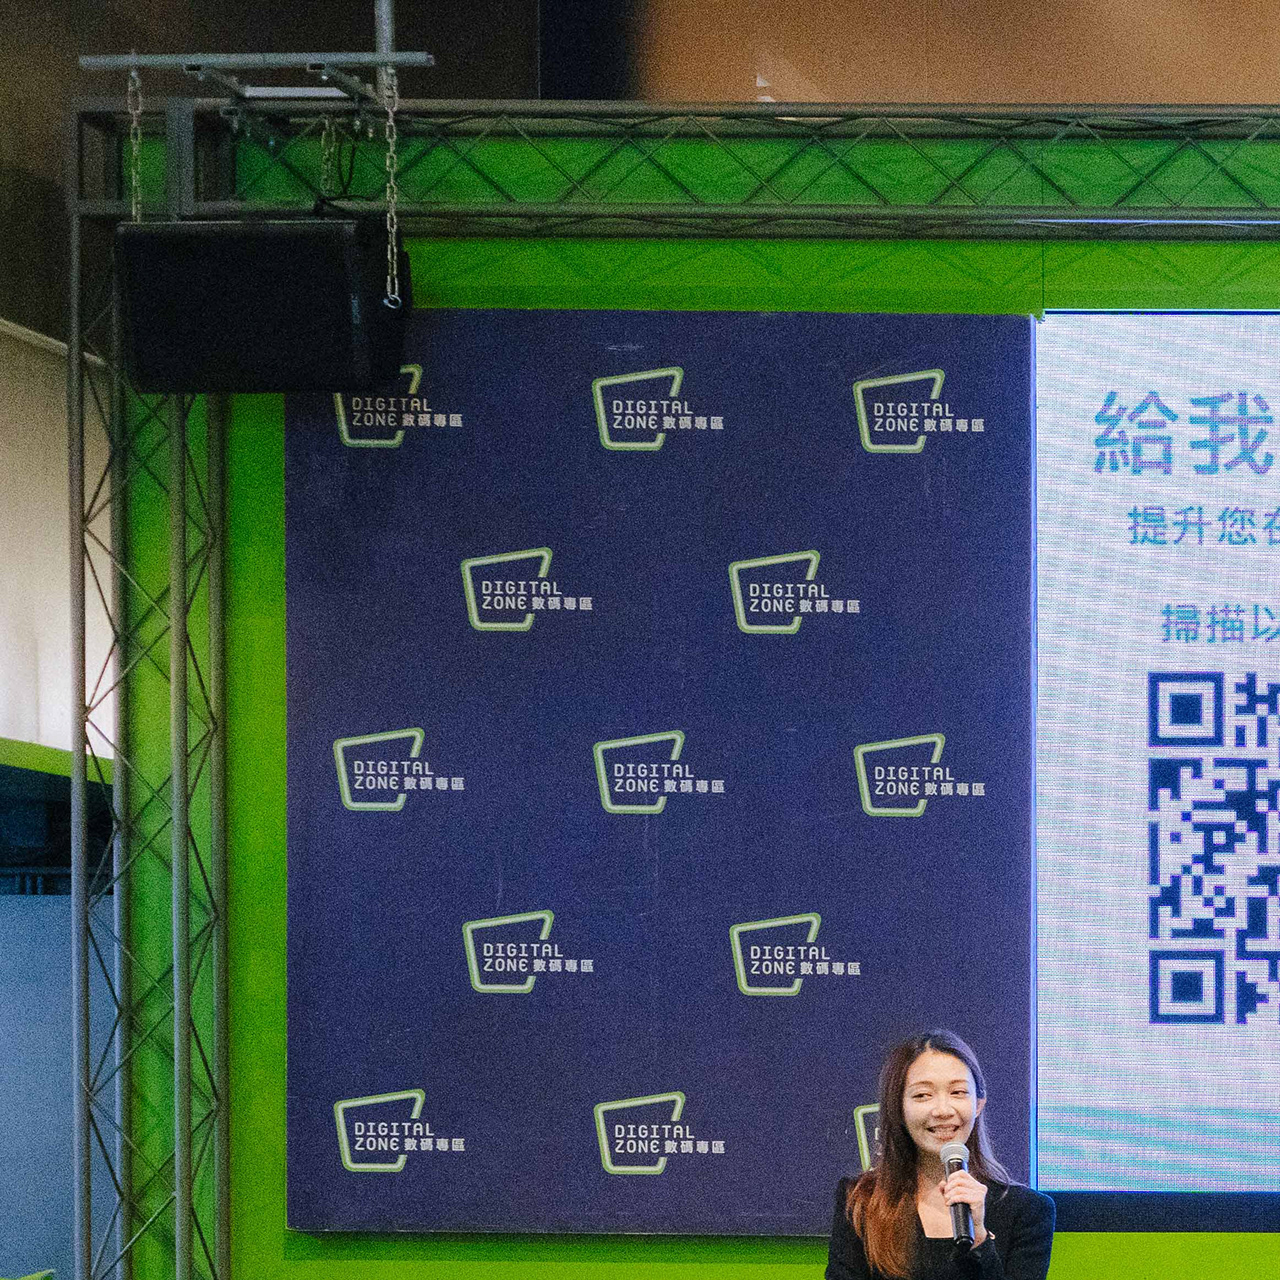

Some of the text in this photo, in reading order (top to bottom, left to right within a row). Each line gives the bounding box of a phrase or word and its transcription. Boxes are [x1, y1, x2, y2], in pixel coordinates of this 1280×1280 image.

[352, 397, 432, 412] DIGITAL
[613, 399, 692, 414] DIGITAL
[874, 402, 954, 417] DIGITAL
[353, 412, 462, 427] ZONE 數碼專區
[613, 414, 723, 429] ZONE 數碼專區
[874, 417, 984, 432] ZONE 數碼專區
[482, 580, 561, 595] DIGITAL
[750, 583, 829, 598] DIGITAL
[482, 595, 592, 610] ZONE 數碼專區
[750, 598, 859, 613] ZONE 數碼專區
[354, 760, 433, 775] DIGITAL
[614, 763, 694, 778] DIGITAL
[875, 766, 954, 781] DIGITAL
[354, 775, 464, 790] ZONE 數碼專區
[615, 778, 724, 793] ZONE 數碼專區
[875, 781, 985, 795] ZONE 數碼專區
[484, 942, 562, 957] DIGITAL
[751, 945, 830, 960] DIGITAL
[484, 957, 593, 972] ZONE 數碼專區
[751, 960, 860, 975] ZONE 數碼專區
[355, 1121, 434, 1136] DIGITAL
[615, 1124, 694, 1139] DIGITAL
[355, 1136, 464, 1151] ZONE 數碼專區
[615, 1139, 724, 1153] ZONE 數碼專區
